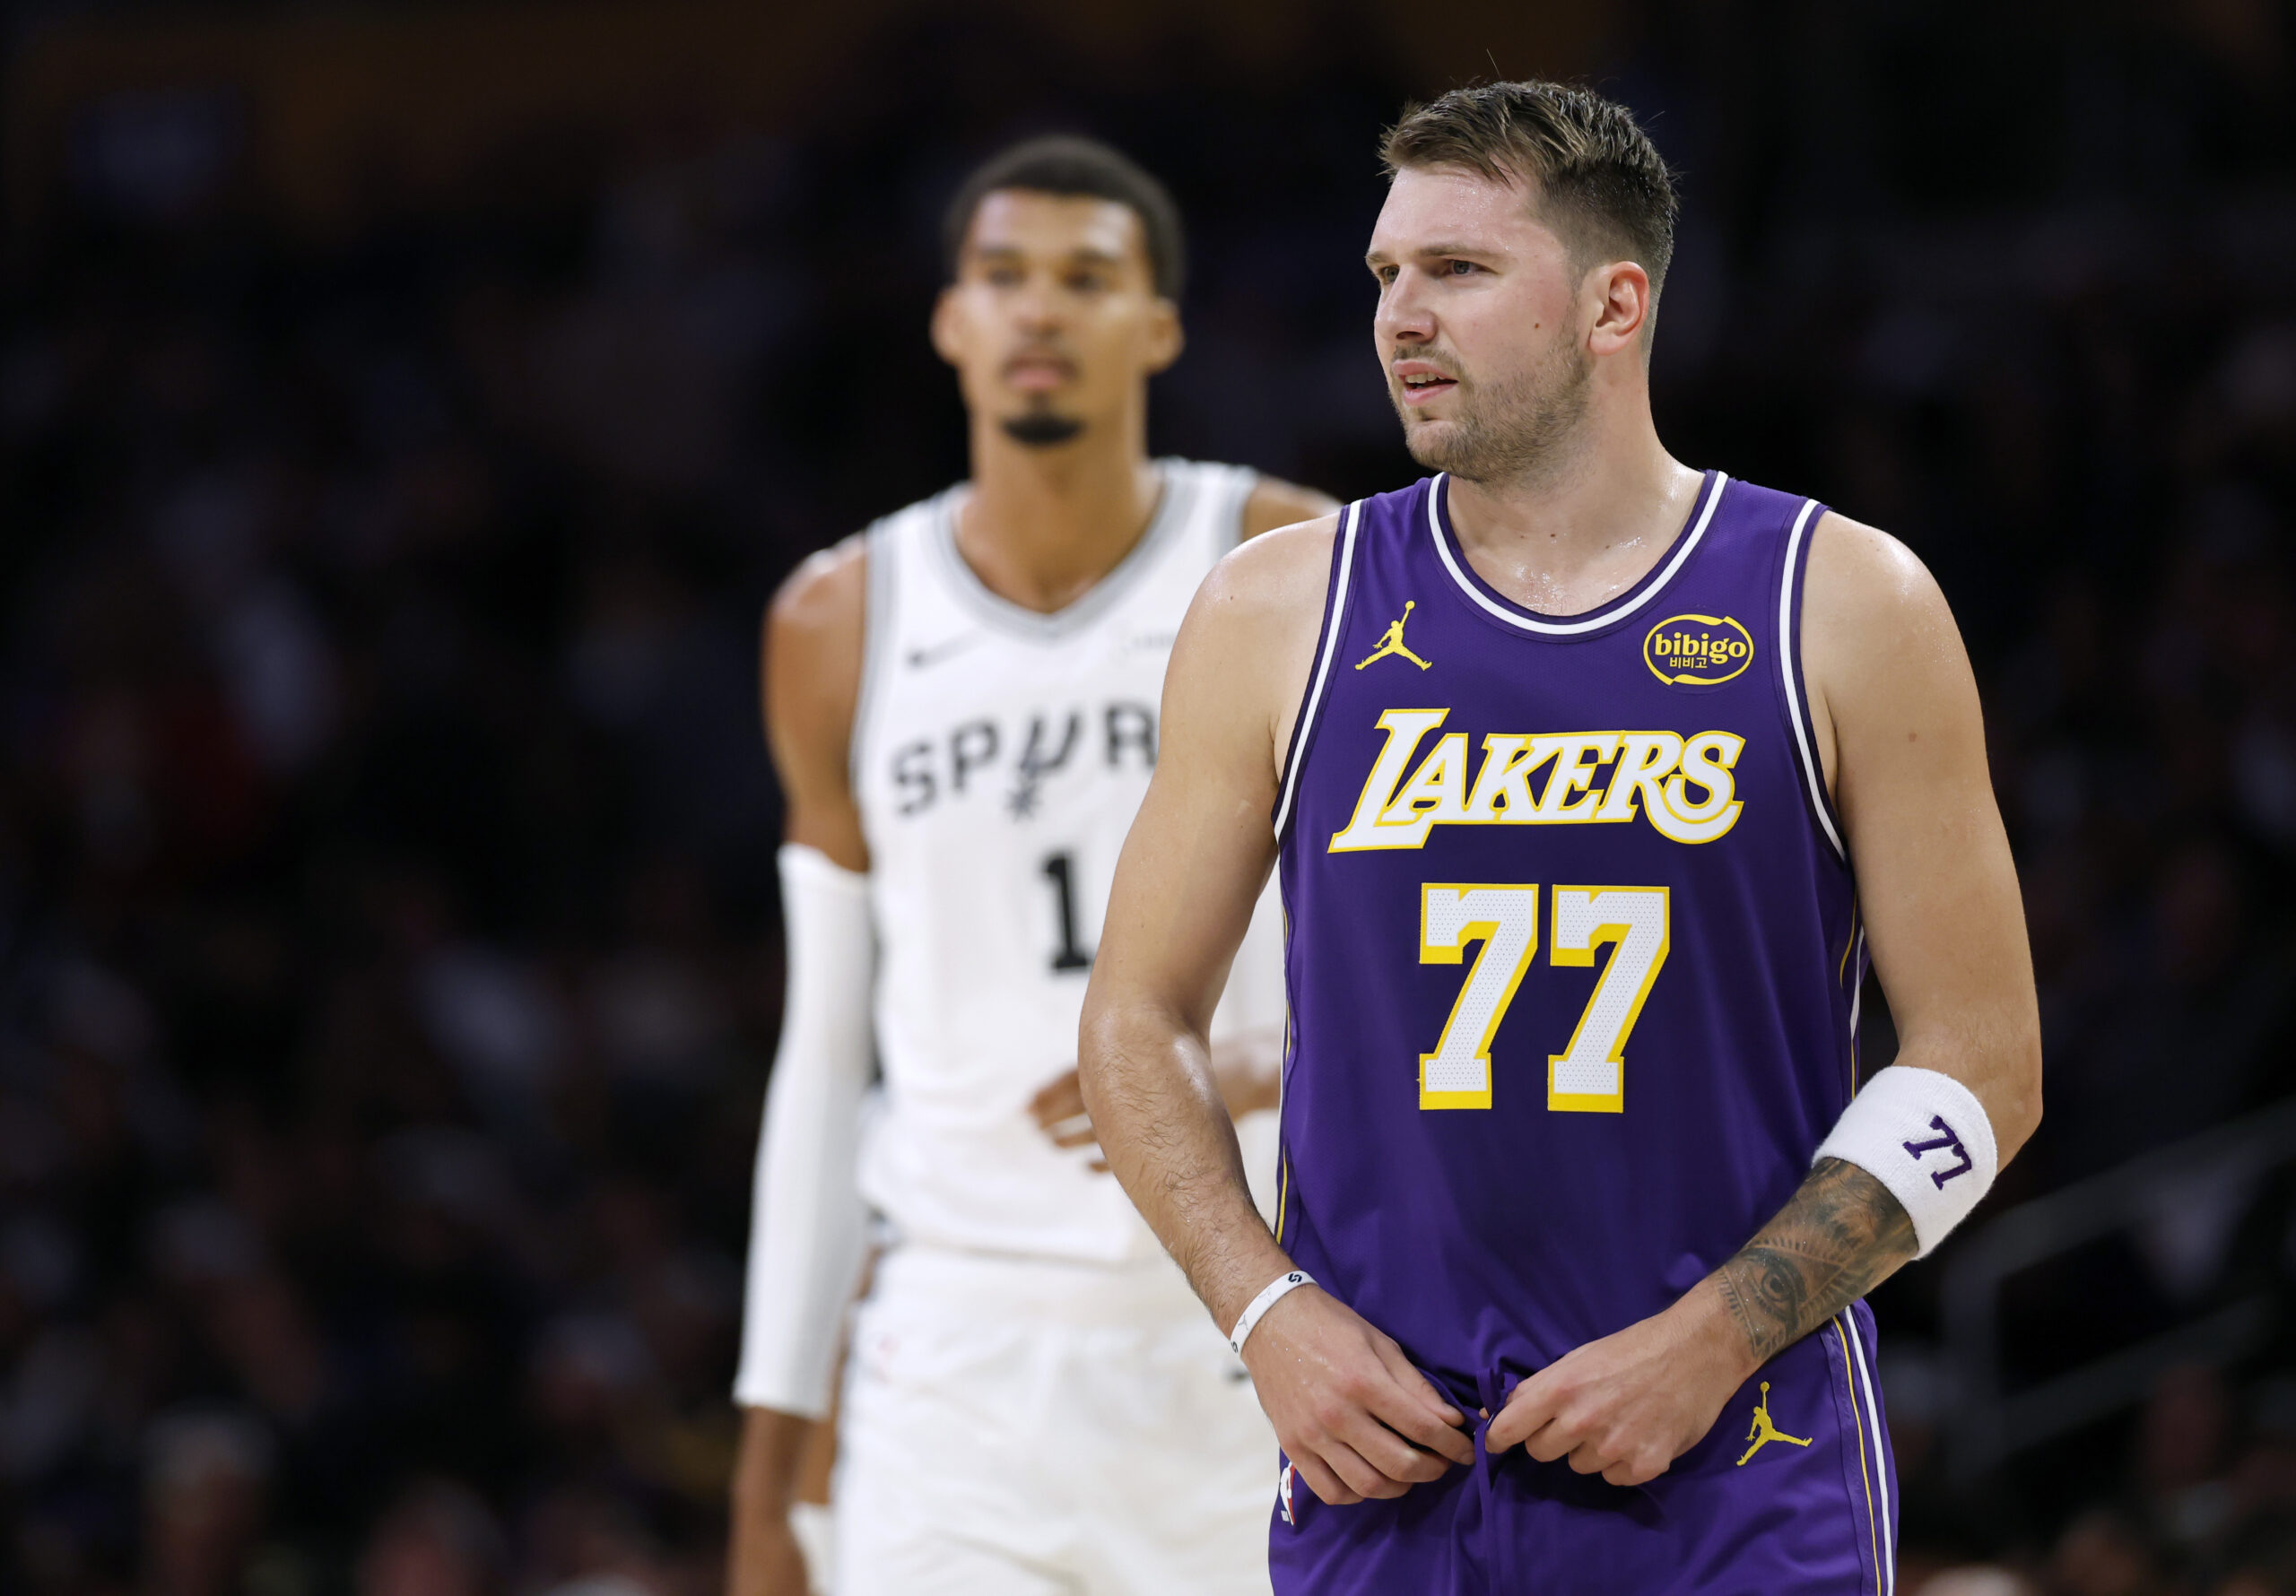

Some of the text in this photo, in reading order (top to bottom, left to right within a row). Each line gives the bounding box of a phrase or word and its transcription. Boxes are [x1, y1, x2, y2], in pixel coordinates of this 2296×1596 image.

[1655, 632, 1747, 664] bibigo
[1669, 657, 1708, 669] 비비고
[1327, 707, 1746, 854] LAKERS
[1043, 850, 1091, 973] 1
[1419, 882, 1670, 1113] 77
[1902, 1115, 1972, 1191] 77
